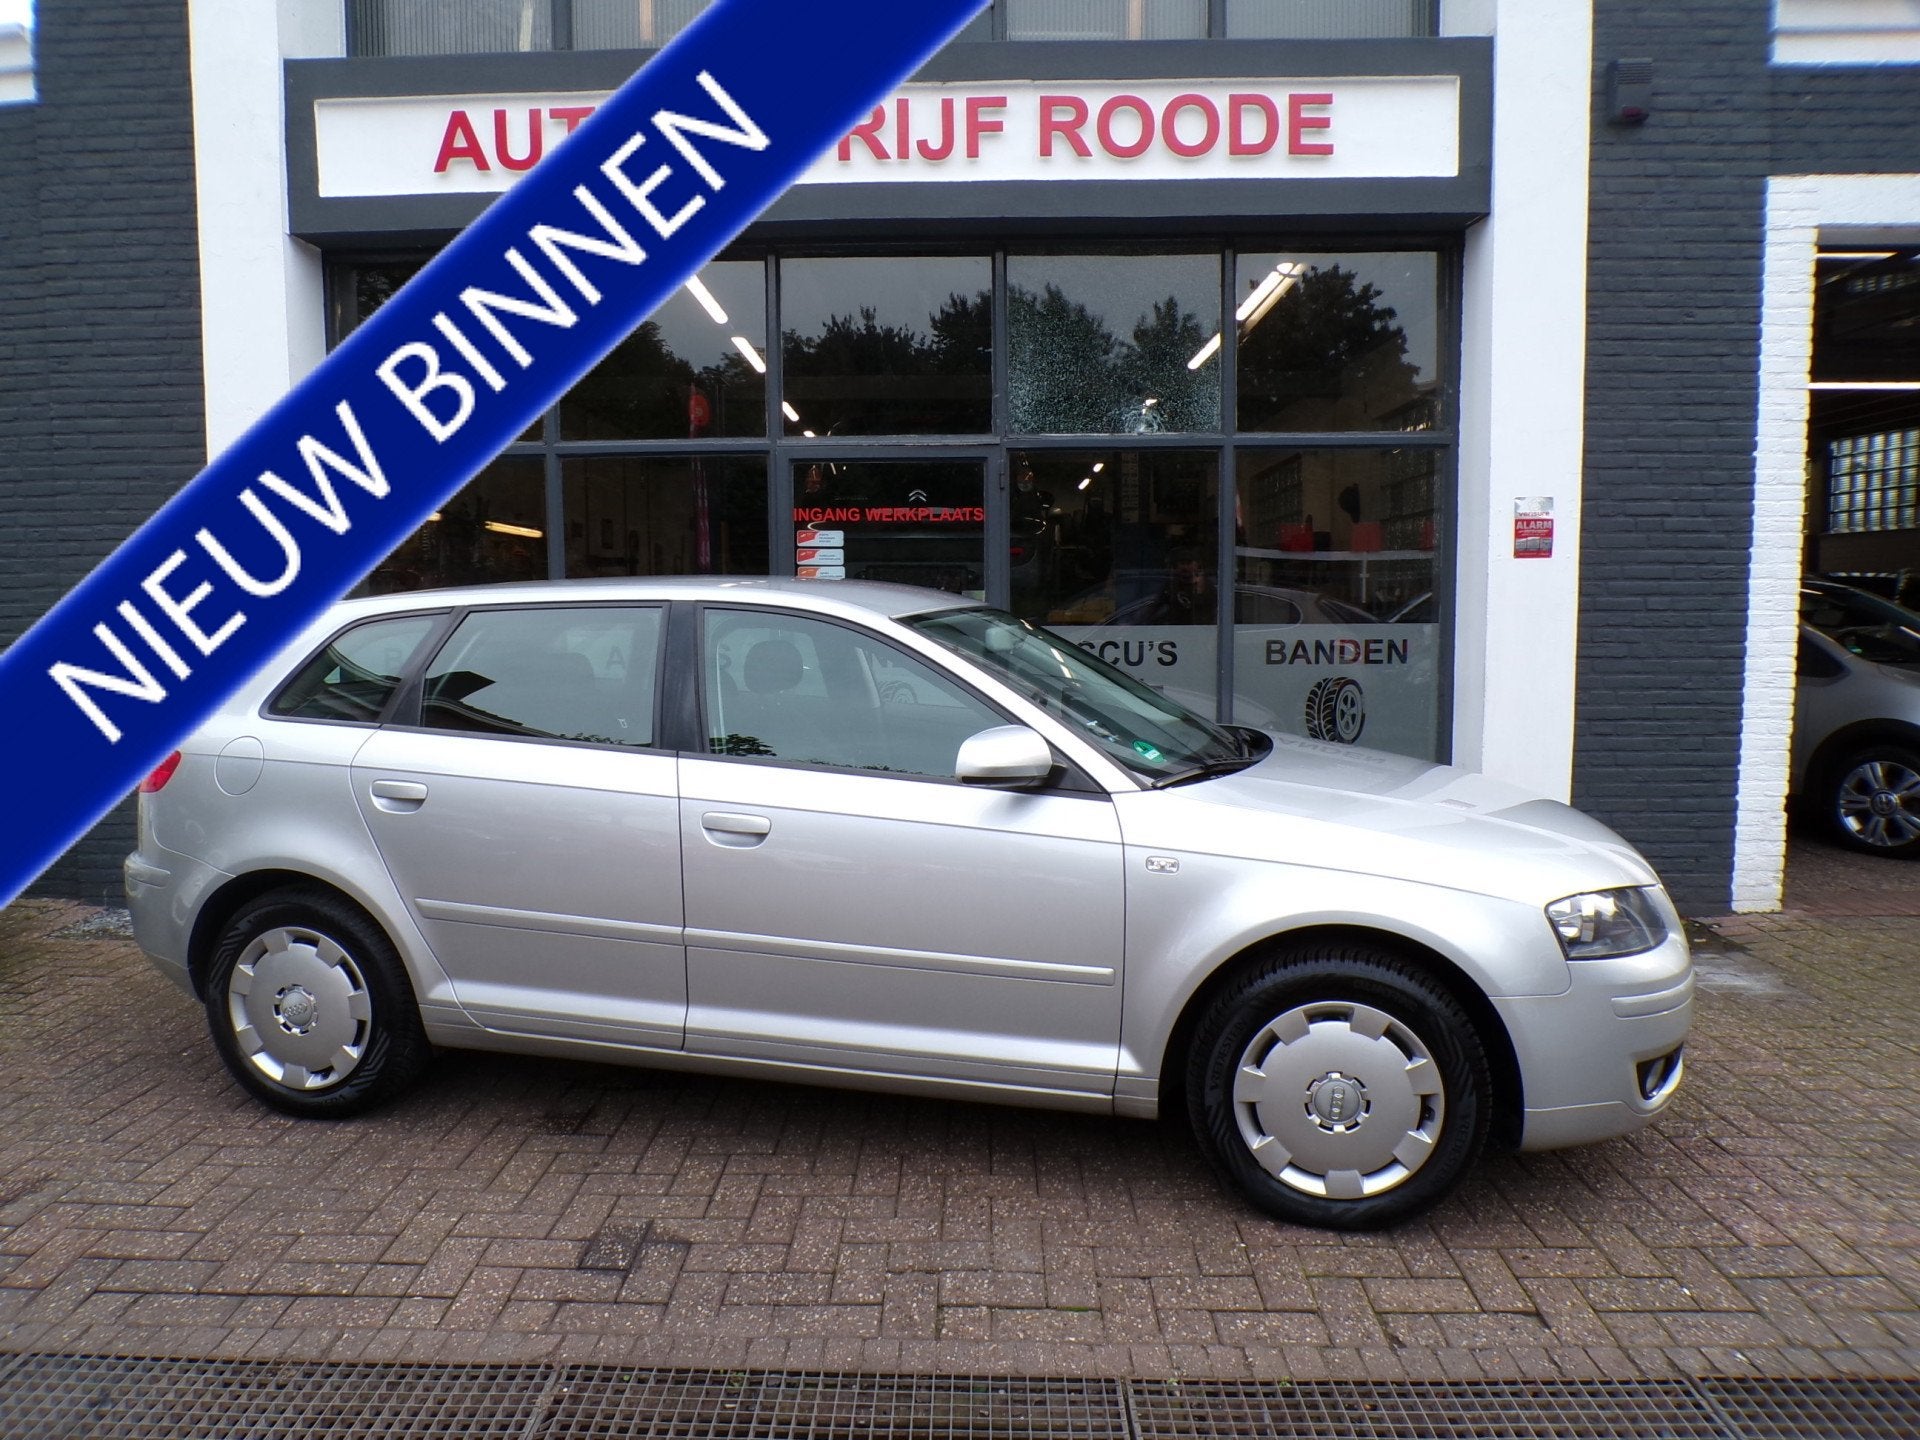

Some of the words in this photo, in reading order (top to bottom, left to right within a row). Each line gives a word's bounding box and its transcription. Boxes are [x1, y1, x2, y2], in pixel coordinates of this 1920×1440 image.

[1039, 93, 1335, 158] ROODE
[793, 507, 861, 522] INGANG
[866, 507, 985, 522] WERKPLAATS
[1516, 520, 1552, 530] ALARM
[1265, 638, 1409, 665] BANDEN
